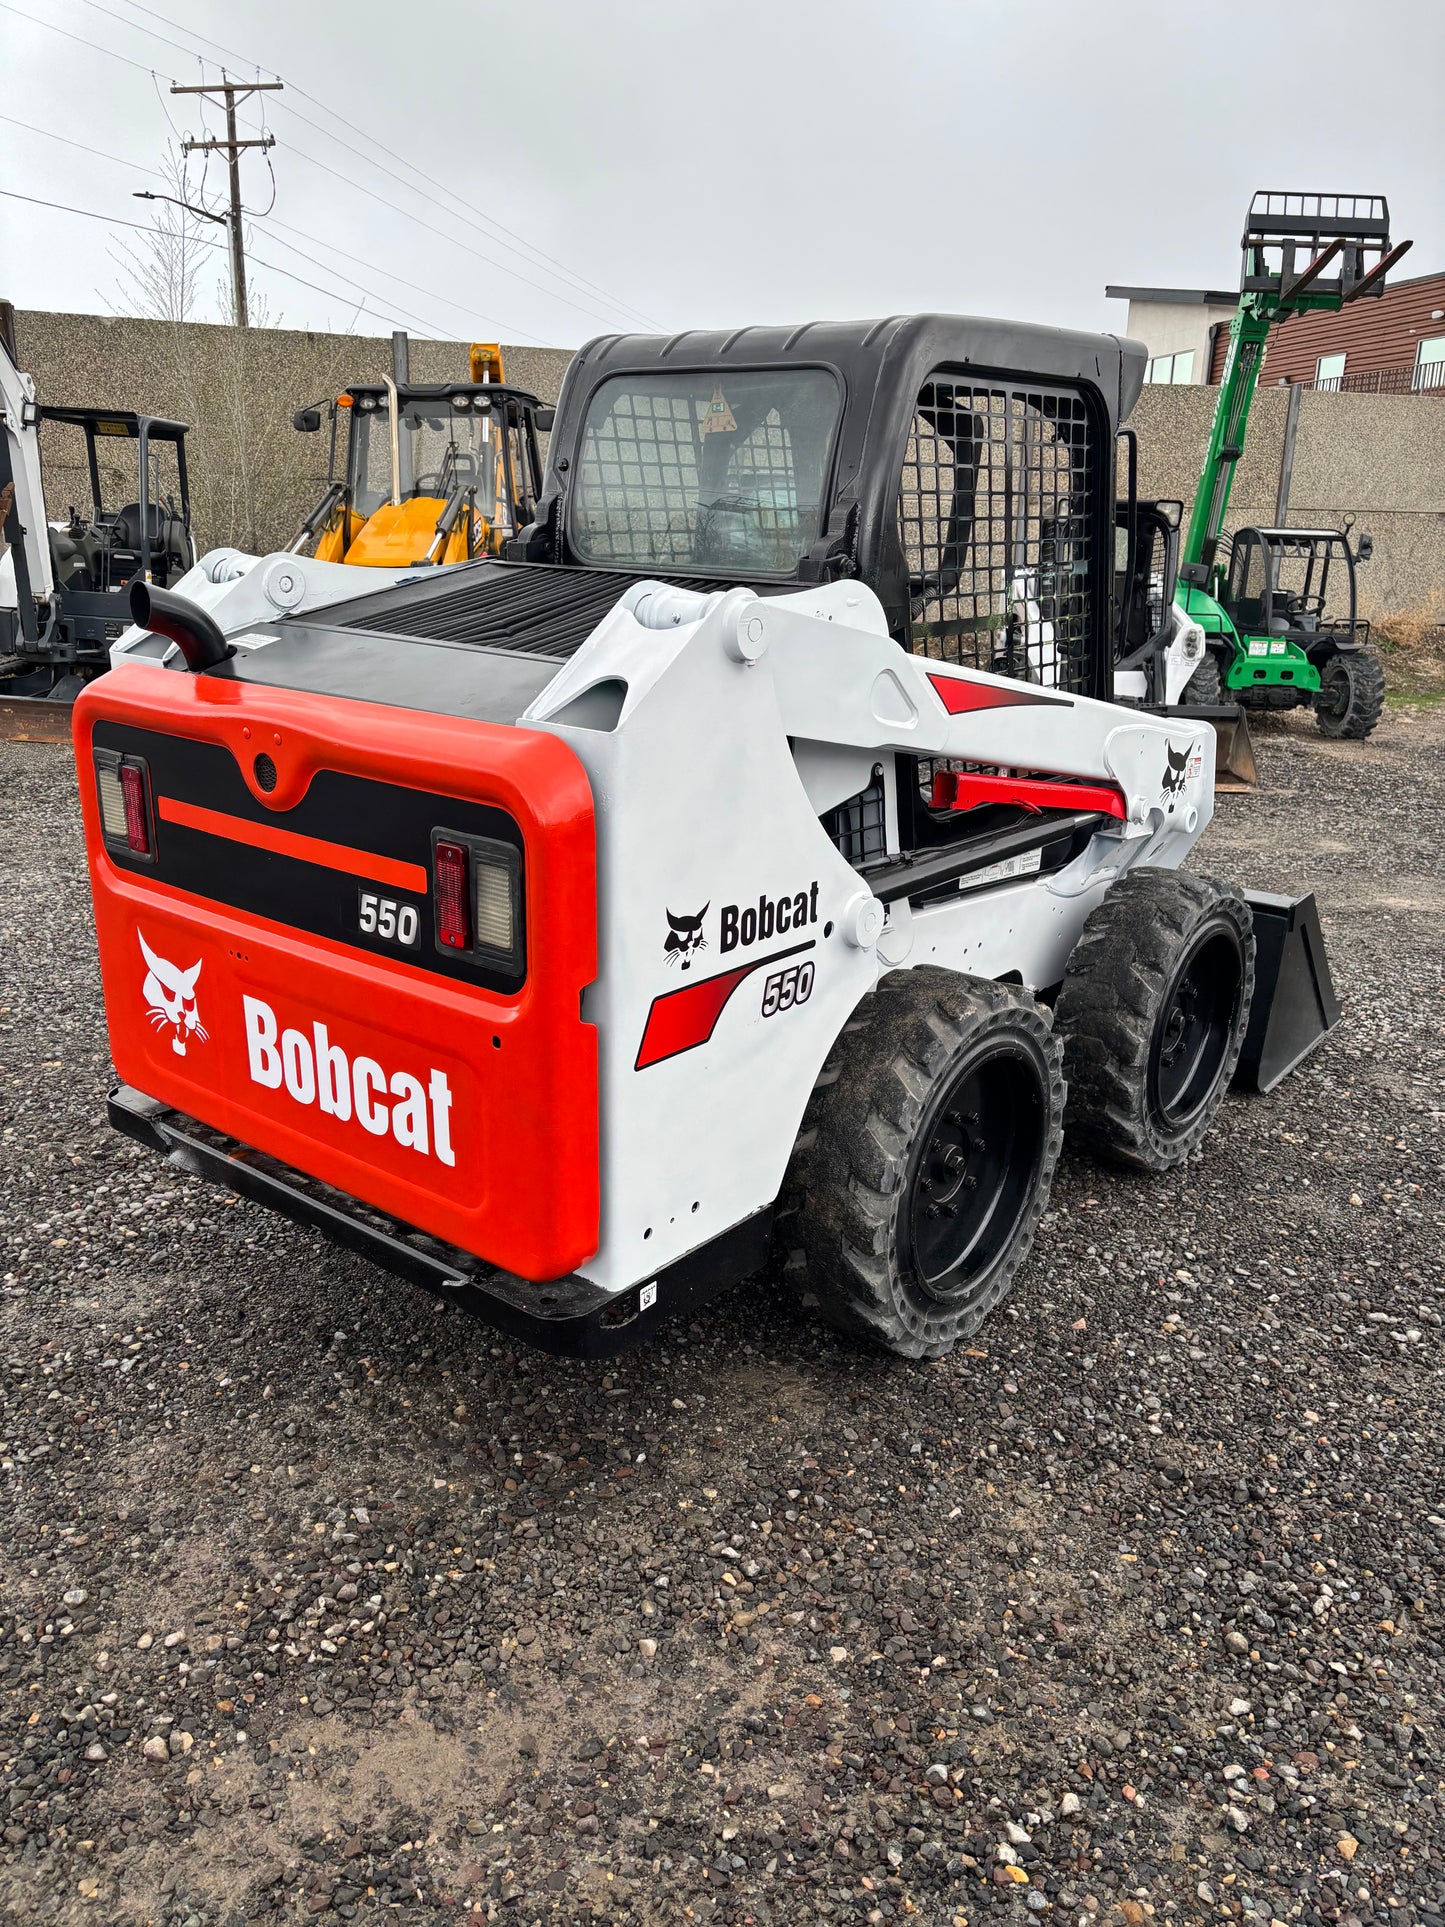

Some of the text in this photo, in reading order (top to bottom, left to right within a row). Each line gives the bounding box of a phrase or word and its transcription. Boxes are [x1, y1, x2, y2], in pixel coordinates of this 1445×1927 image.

[360, 893, 418, 945] 550
[720, 880, 819, 954] Bobcat
[762, 961, 815, 1018] 550
[242, 993, 456, 1168] Bobcat
